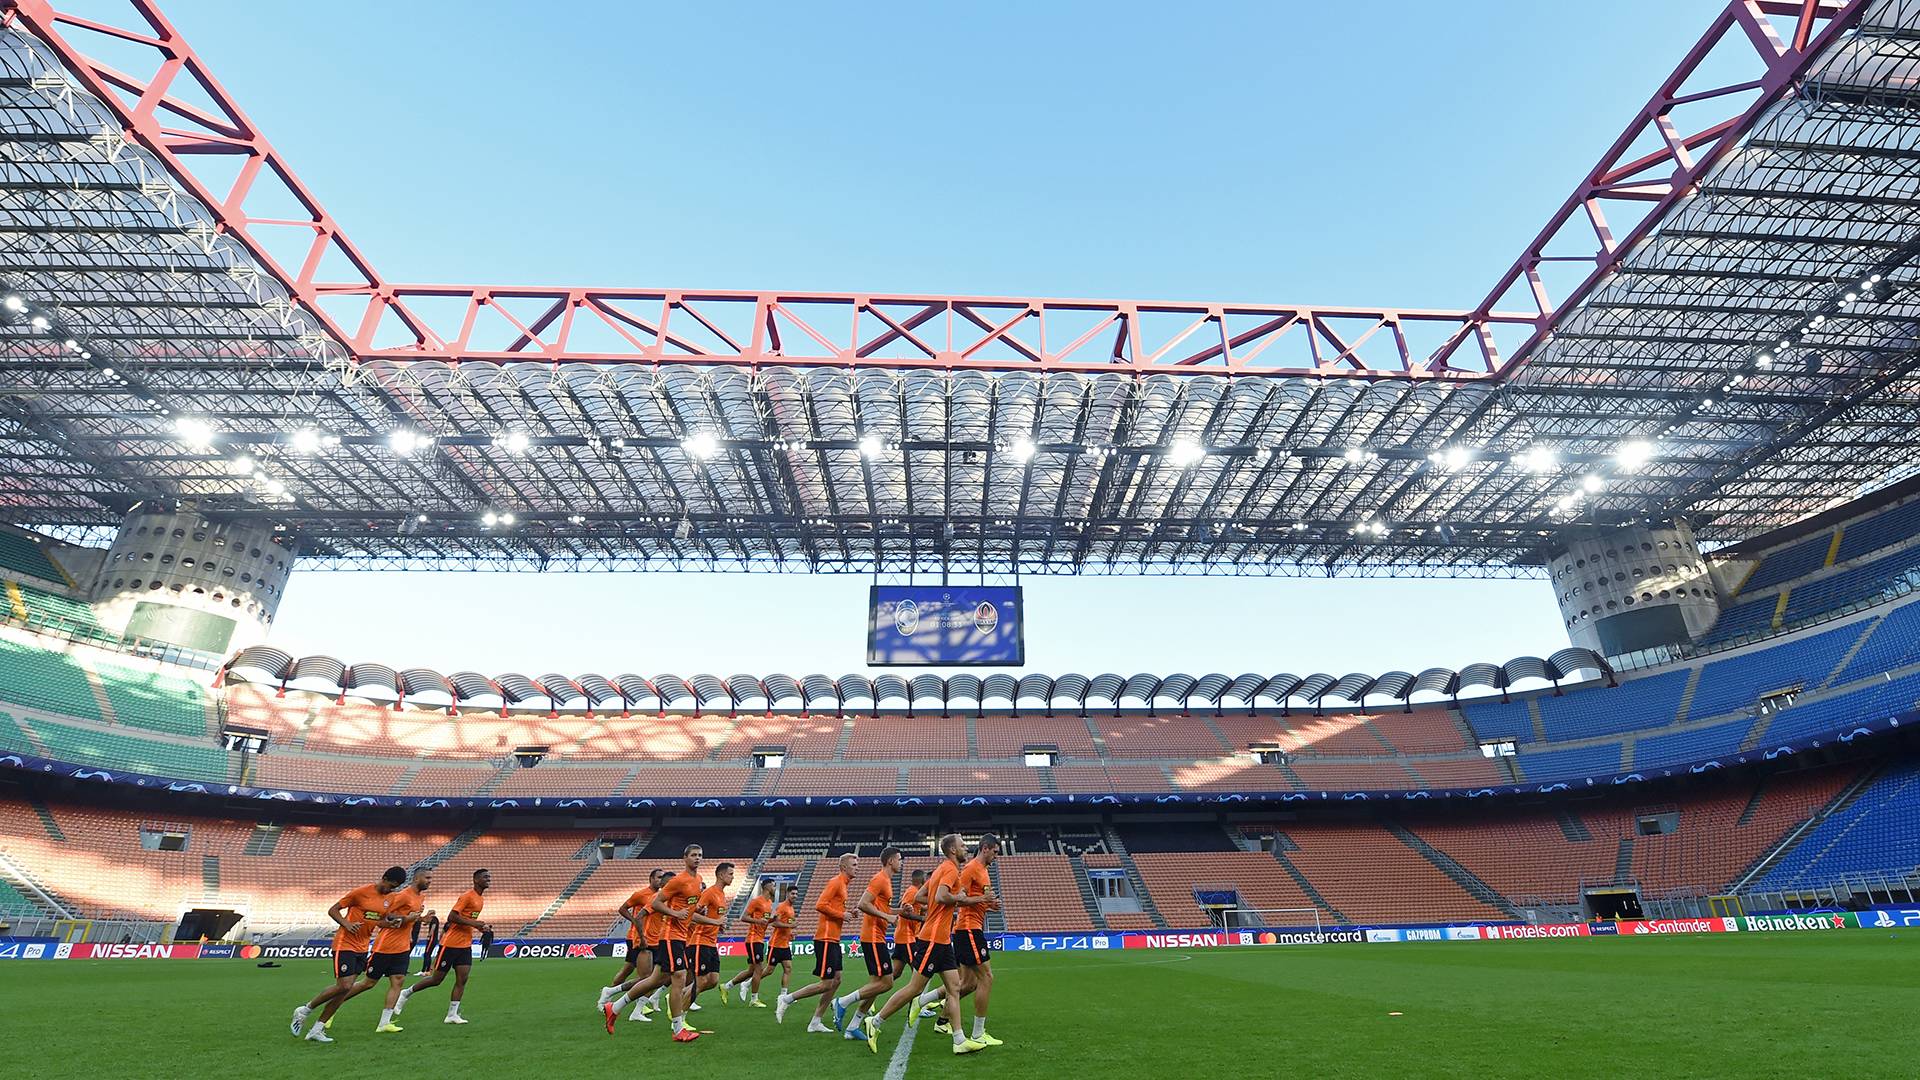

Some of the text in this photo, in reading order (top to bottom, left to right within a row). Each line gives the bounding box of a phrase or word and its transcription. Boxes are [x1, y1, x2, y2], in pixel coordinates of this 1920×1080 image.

[1650, 920, 1711, 934] Santander
[1744, 914, 1831, 931] Heineken
[1280, 931, 1361, 944] mastercard
[1406, 929, 1441, 940] GAZPROM
[1503, 924, 1578, 938] Hotels.com
[1041, 937, 1089, 949] PS4
[1147, 935, 1217, 948] NISSAN
[27, 947, 41, 955] Pro
[90, 944, 173, 959] NISSAN
[519, 944, 597, 958] pepsi MAX
